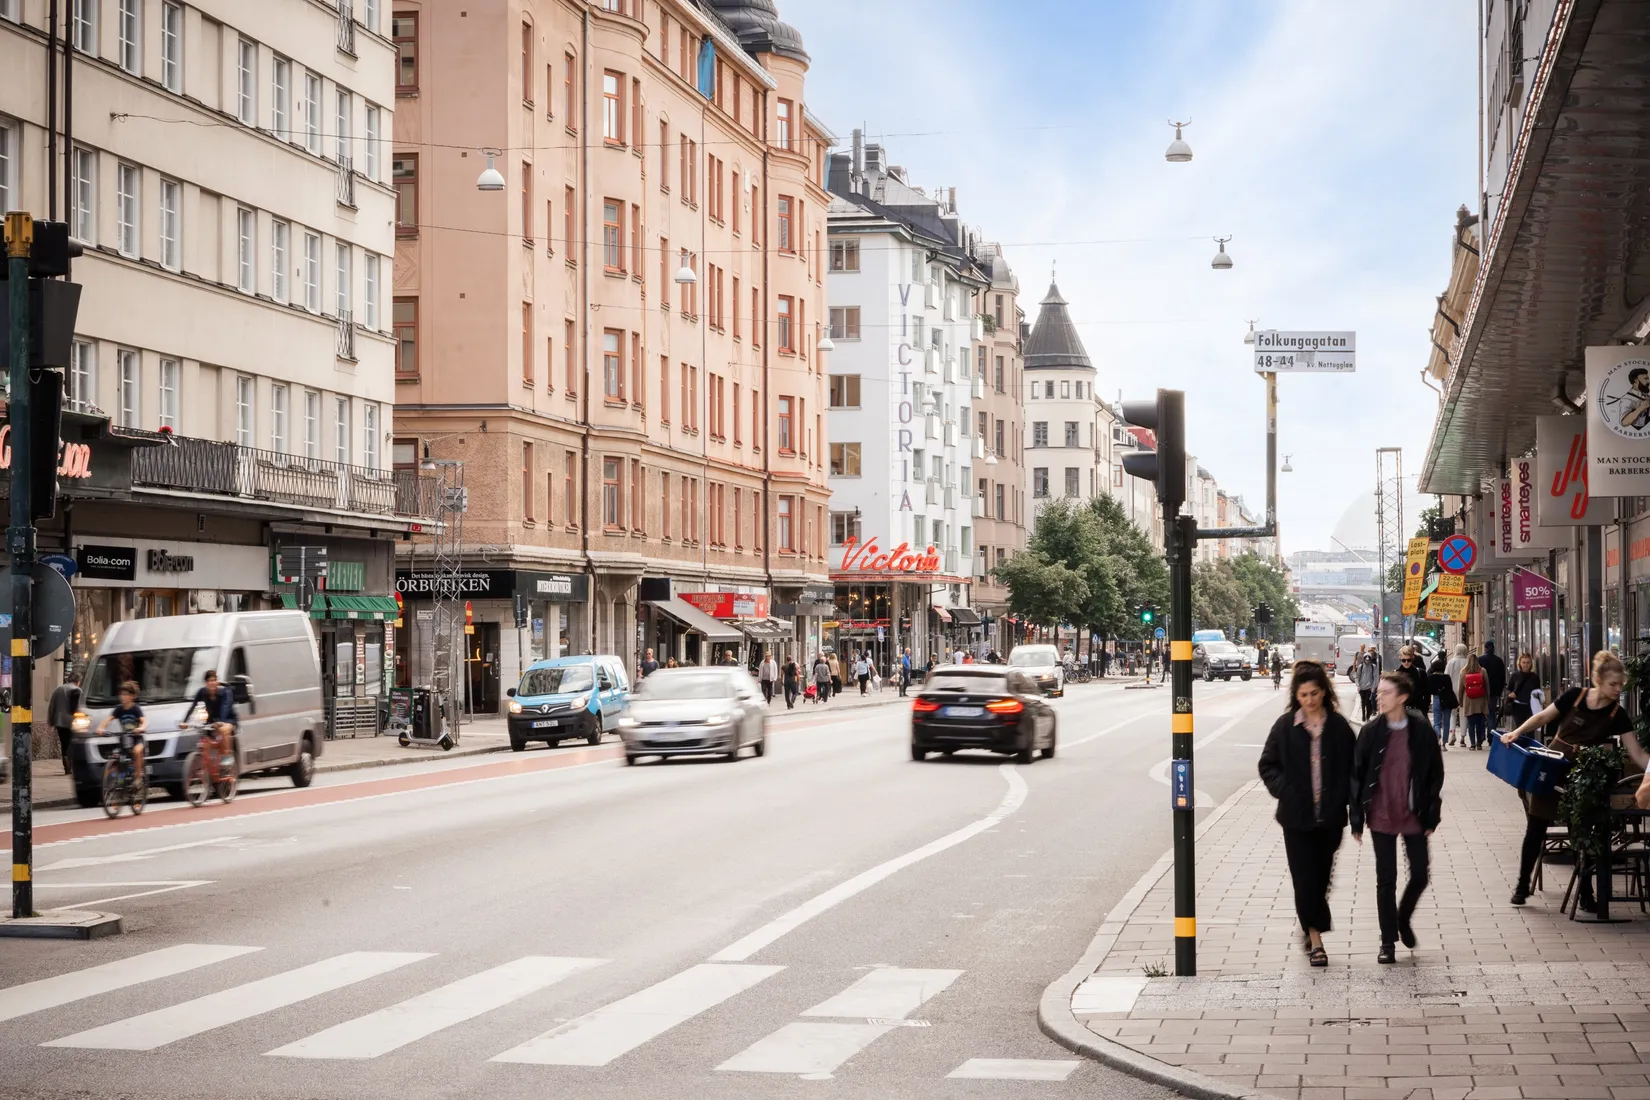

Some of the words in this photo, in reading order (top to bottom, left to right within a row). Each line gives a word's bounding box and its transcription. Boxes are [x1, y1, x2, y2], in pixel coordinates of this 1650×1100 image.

[1258, 334, 1346, 349] Folkungagatan
[1257, 355, 1294, 368] 48-44
[1607, 364, 1622, 377] MAN
[898, 283, 912, 511] VICTORIA
[1519, 461, 1532, 543] smarteyes
[1501, 482, 1512, 553] smarteyes
[841, 535, 940, 571] Victoria
[1525, 586, 1550, 597] 50%
